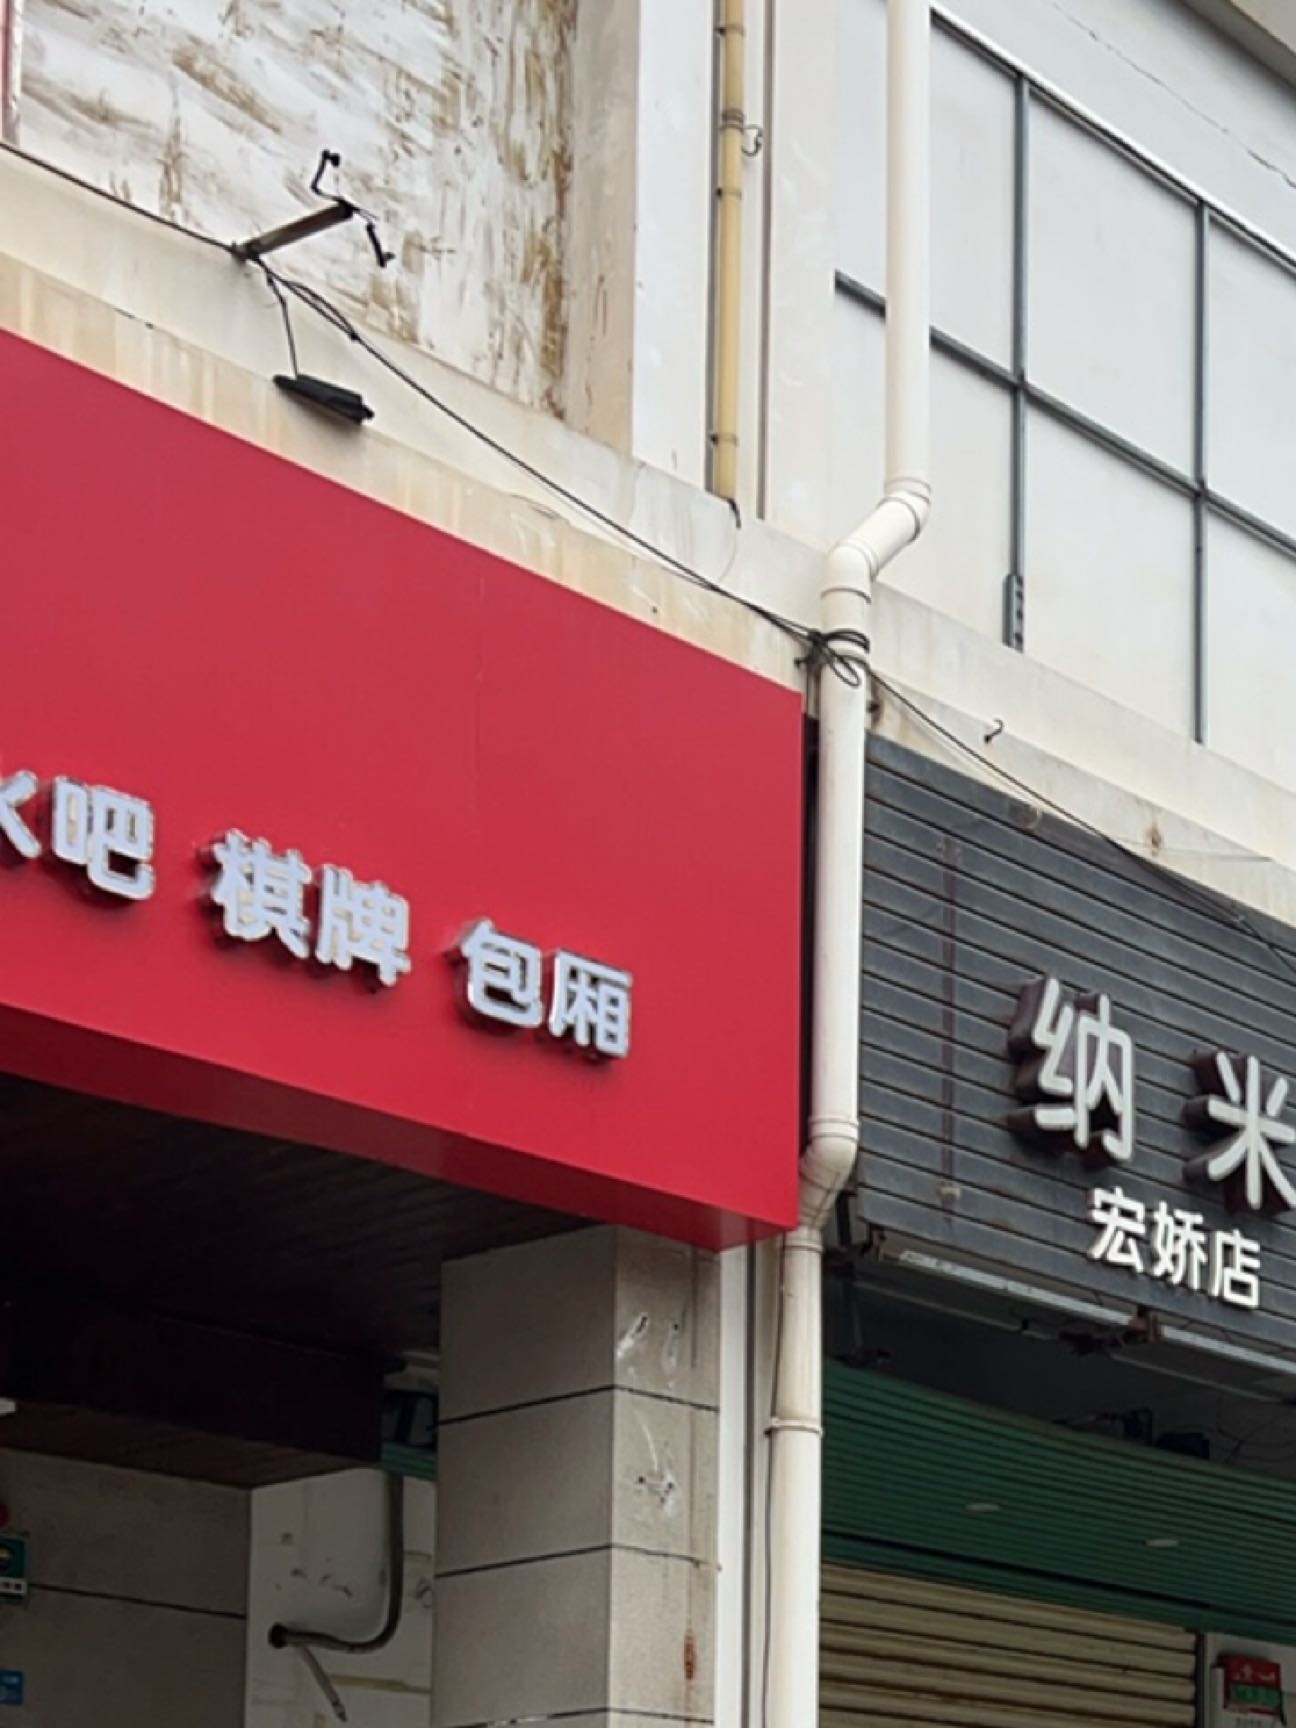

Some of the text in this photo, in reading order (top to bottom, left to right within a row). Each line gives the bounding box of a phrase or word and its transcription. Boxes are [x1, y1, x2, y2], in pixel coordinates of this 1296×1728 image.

[210, 829, 410, 986] 棋牌
[458, 919, 633, 1057] 包厢
[1087, 1187, 1262, 1309] 宏娇店
